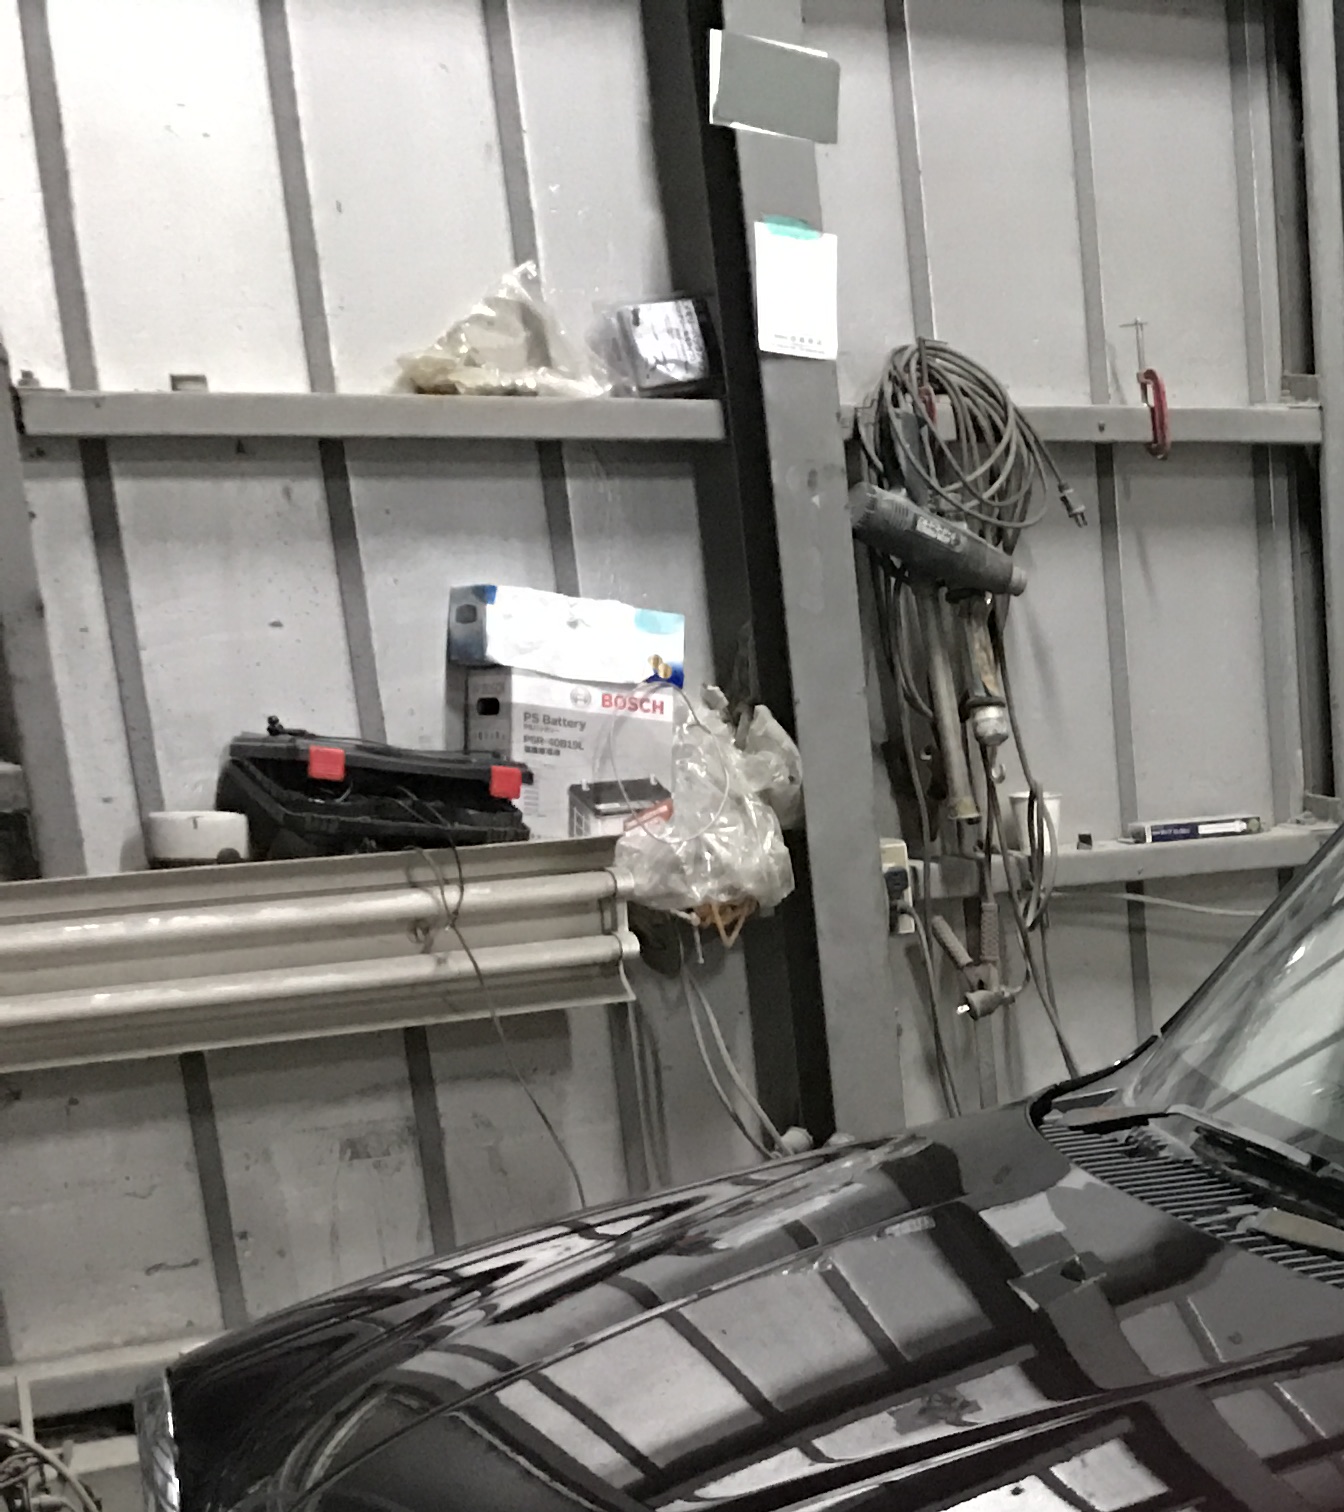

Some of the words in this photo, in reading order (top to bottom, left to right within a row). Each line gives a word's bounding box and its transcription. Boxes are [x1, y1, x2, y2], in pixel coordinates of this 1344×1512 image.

[601, 693, 665, 715] BOSCH
[523, 711, 540, 724] PS
[542, 713, 587, 732] Battery
